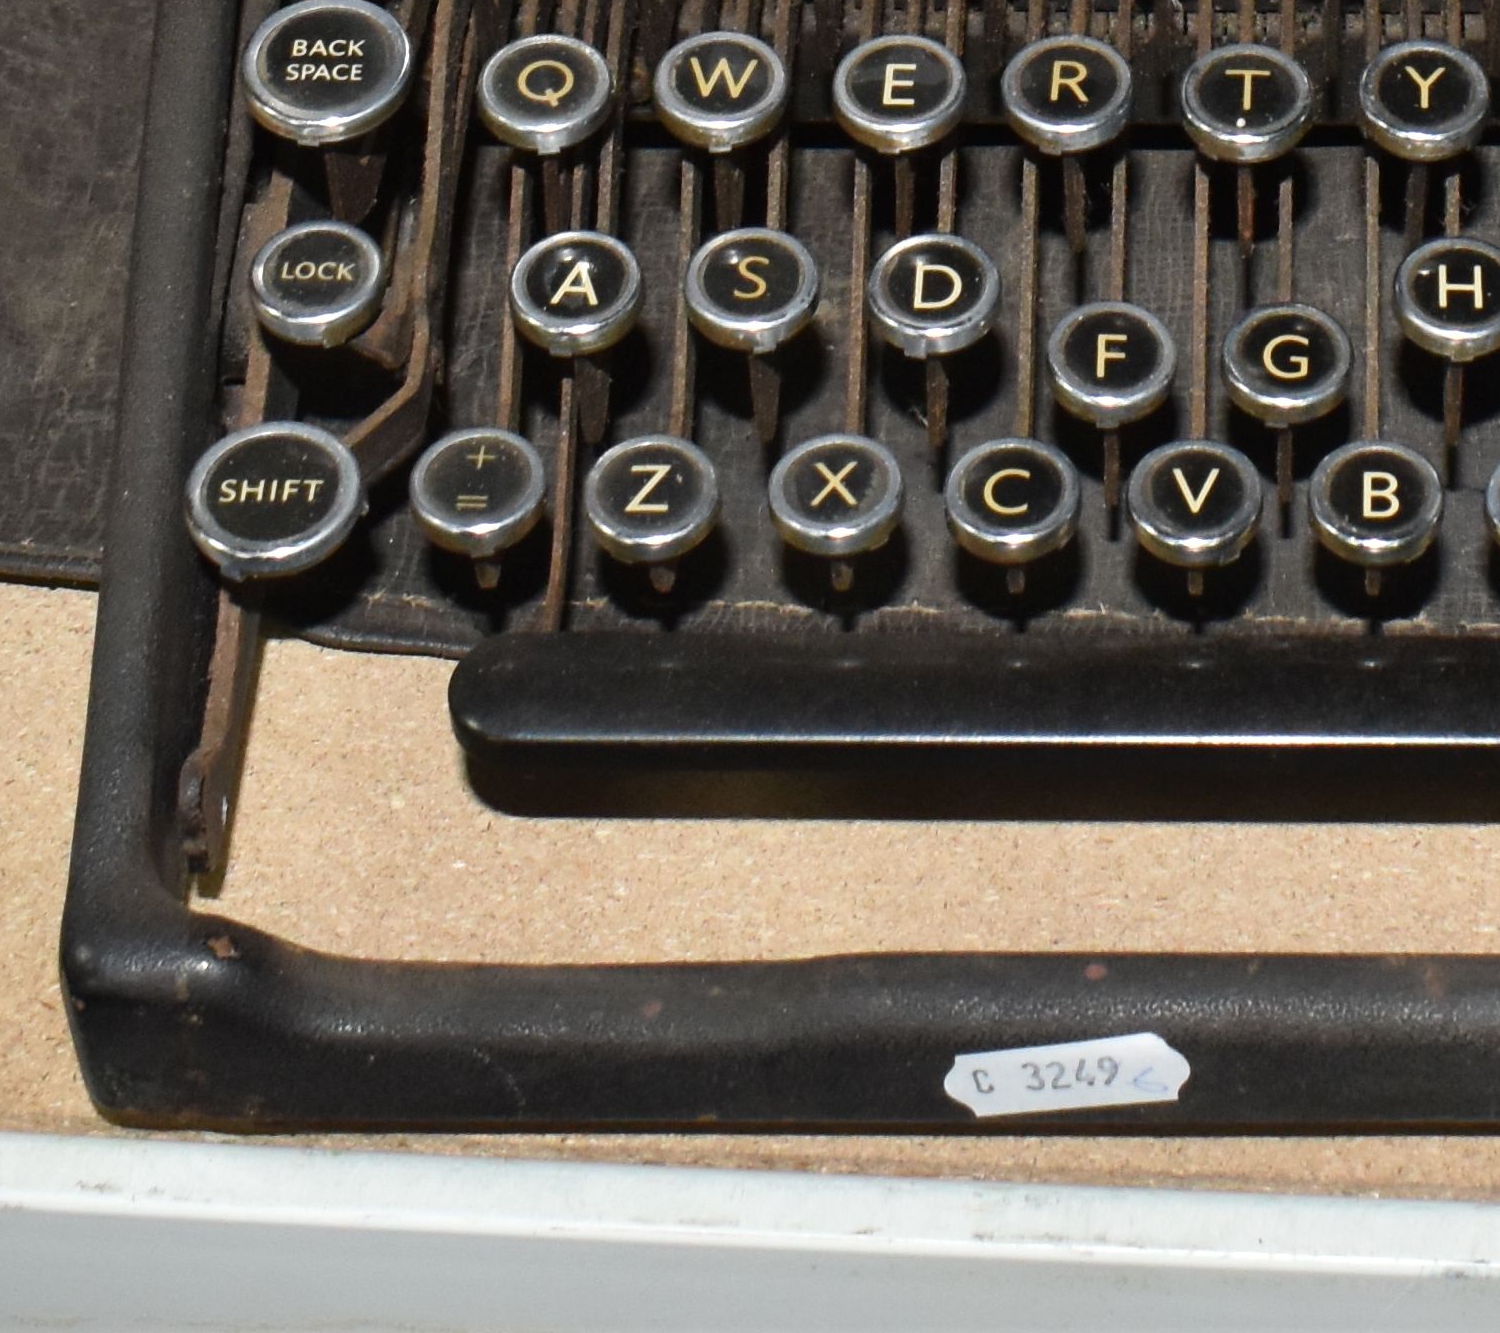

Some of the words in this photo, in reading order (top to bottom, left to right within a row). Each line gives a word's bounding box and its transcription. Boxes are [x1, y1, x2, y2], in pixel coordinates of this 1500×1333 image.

[291, 38, 365, 59] BACK
[285, 62, 363, 83] SPACE
[517, 60, 575, 108] Q
[690, 56, 758, 99] W
[882, 63, 916, 106] E
[1049, 60, 1088, 103] R
[1225, 69, 1271, 111] T
[1404, 66, 1448, 109] Y
[280, 261, 355, 282] LOCK
[550, 262, 600, 306] A
[732, 256, 770, 300] S
[913, 264, 963, 310] D
[1438, 264, 1483, 309] H
[1095, 334, 1128, 378] F
[1262, 335, 1309, 379] G
[218, 479, 324, 504] SHIFT
[624, 464, 672, 514] Z
[810, 461, 858, 507] X
[983, 469, 1031, 515] C
[1173, 468, 1220, 514] V
[1361, 472, 1400, 519] B
[1021, 1056, 1120, 1092] 3249
